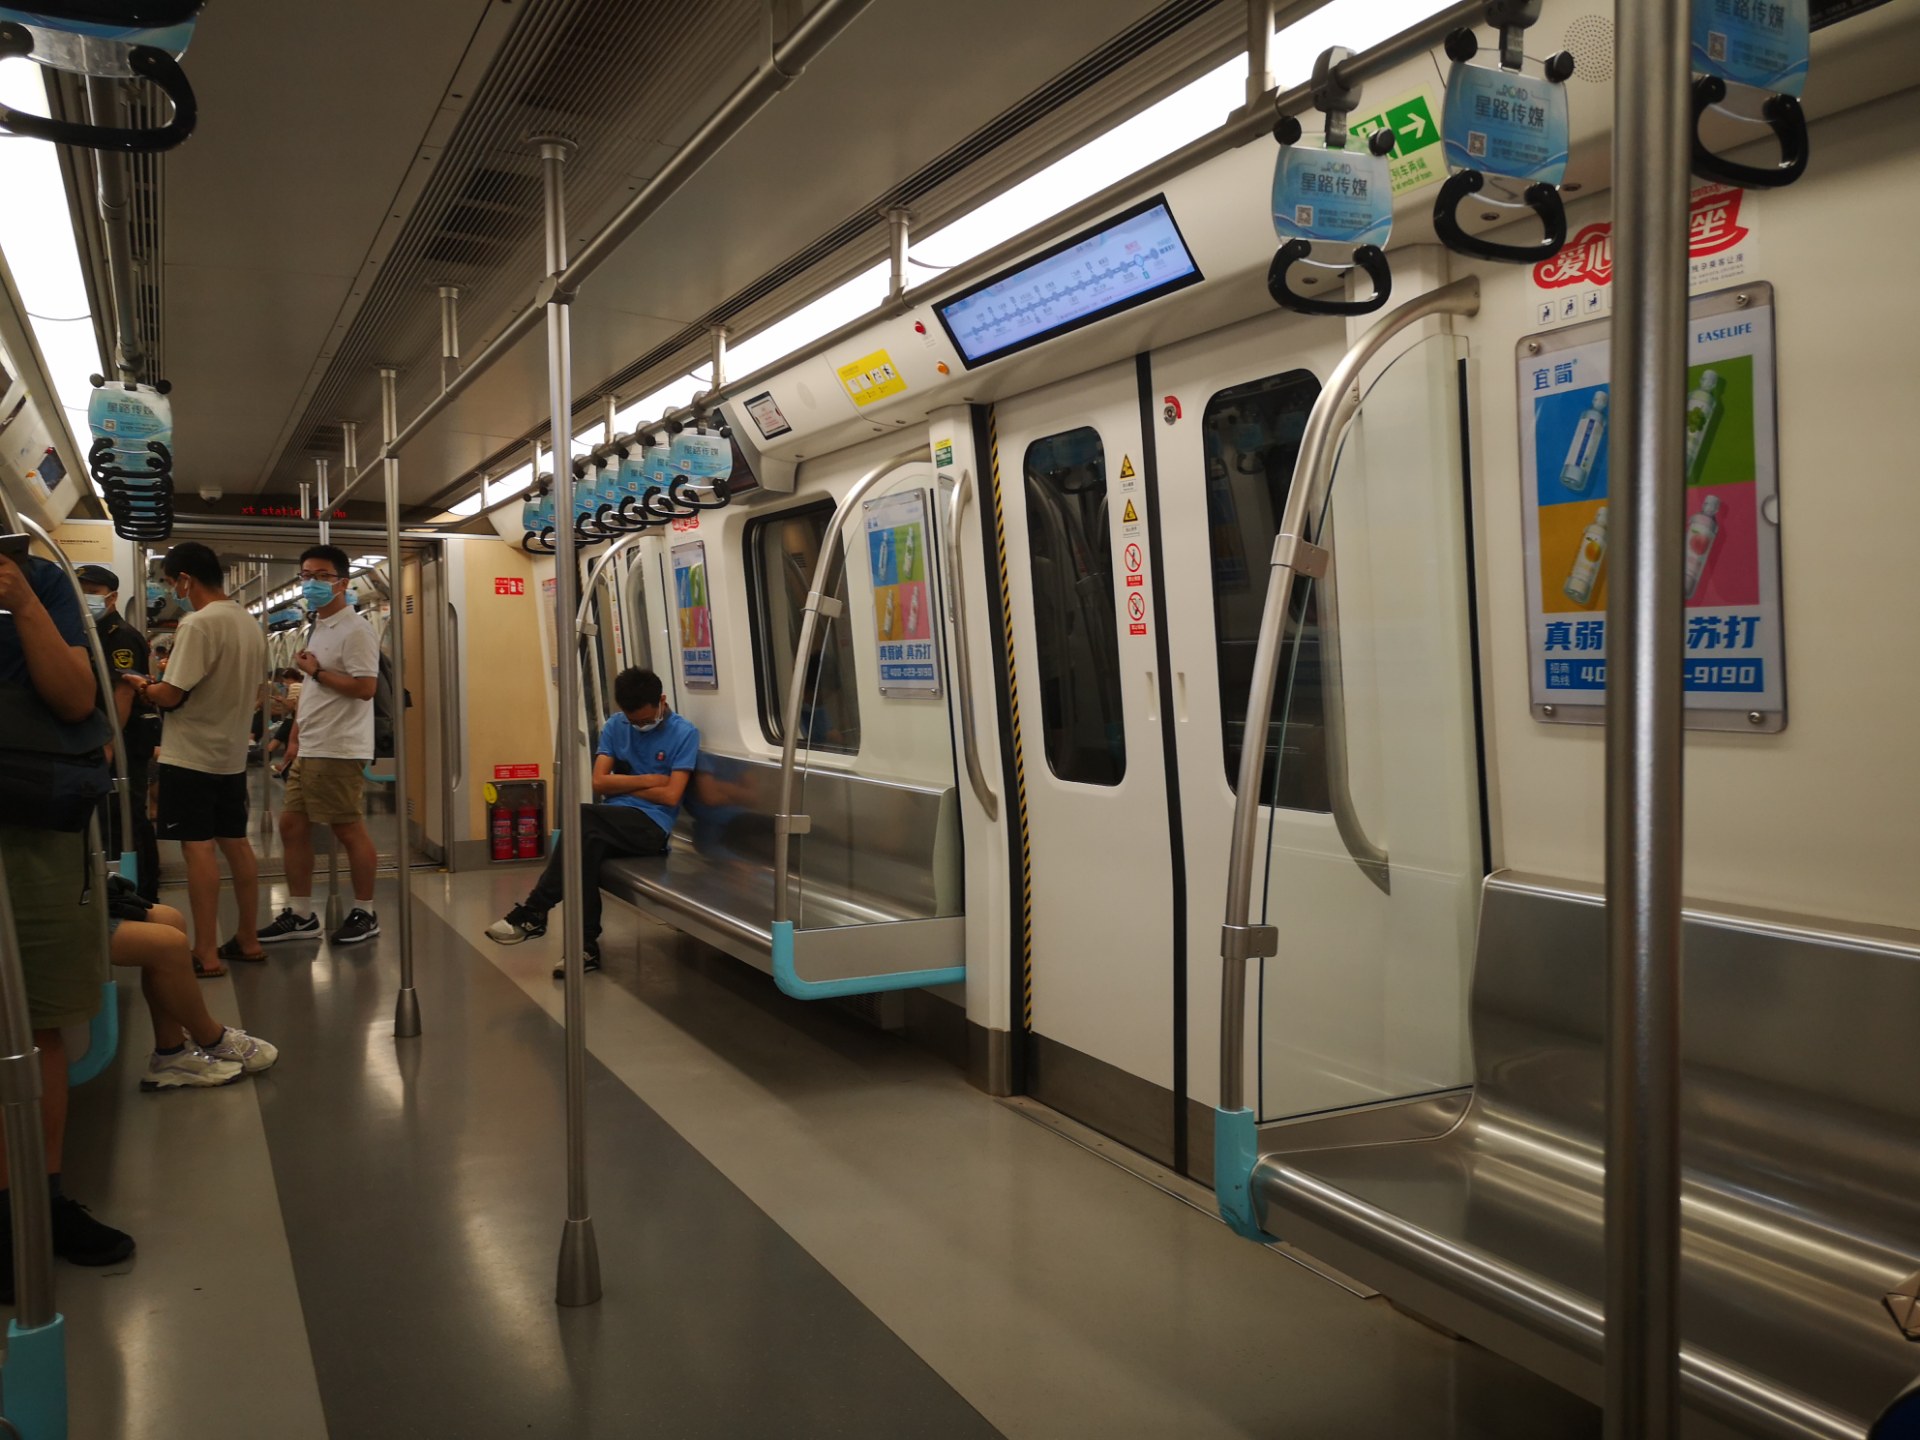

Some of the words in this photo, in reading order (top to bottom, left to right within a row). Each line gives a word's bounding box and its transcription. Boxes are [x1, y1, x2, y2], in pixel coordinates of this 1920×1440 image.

[1475, 95, 1545, 128] 星路传媒
[1300, 173, 1368, 197] 星路传媒
[1697, 322, 1753, 343] EASELIFE
[1533, 362, 1573, 390] 宜简
[261, 506, 304, 517] statio
[1544, 620, 1604, 651] 真弱
[1686, 615, 1761, 649] 苏打
[1683, 666, 1755, 684] -9190
